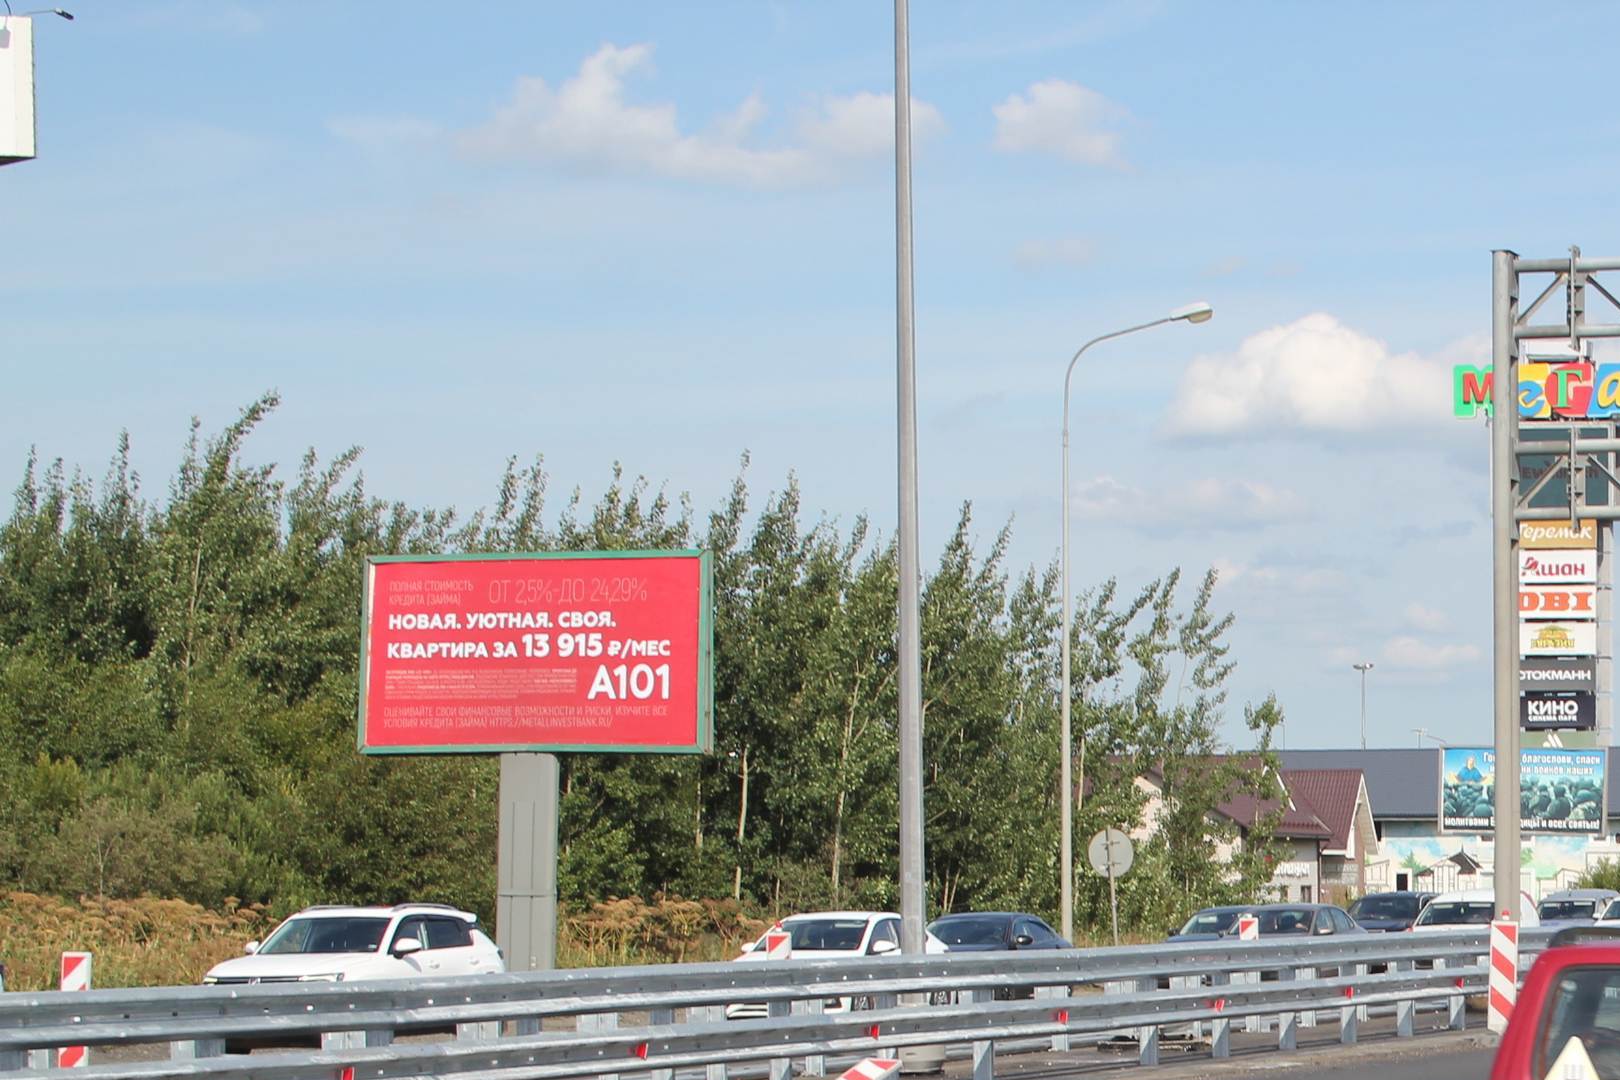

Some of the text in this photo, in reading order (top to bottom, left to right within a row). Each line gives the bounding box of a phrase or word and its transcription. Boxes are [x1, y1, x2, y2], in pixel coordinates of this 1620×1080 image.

[389, 611, 616, 630] НОВАЯ. УЮТНАЯ. СВОЯ.
[387, 642, 489, 659] КВАРТИРА
[493, 641, 517, 657] ЗА
[522, 634, 549, 657] 13
[557, 632, 602, 657] 915
[587, 663, 670, 700] А101
[1528, 699, 1578, 715] КИНО
